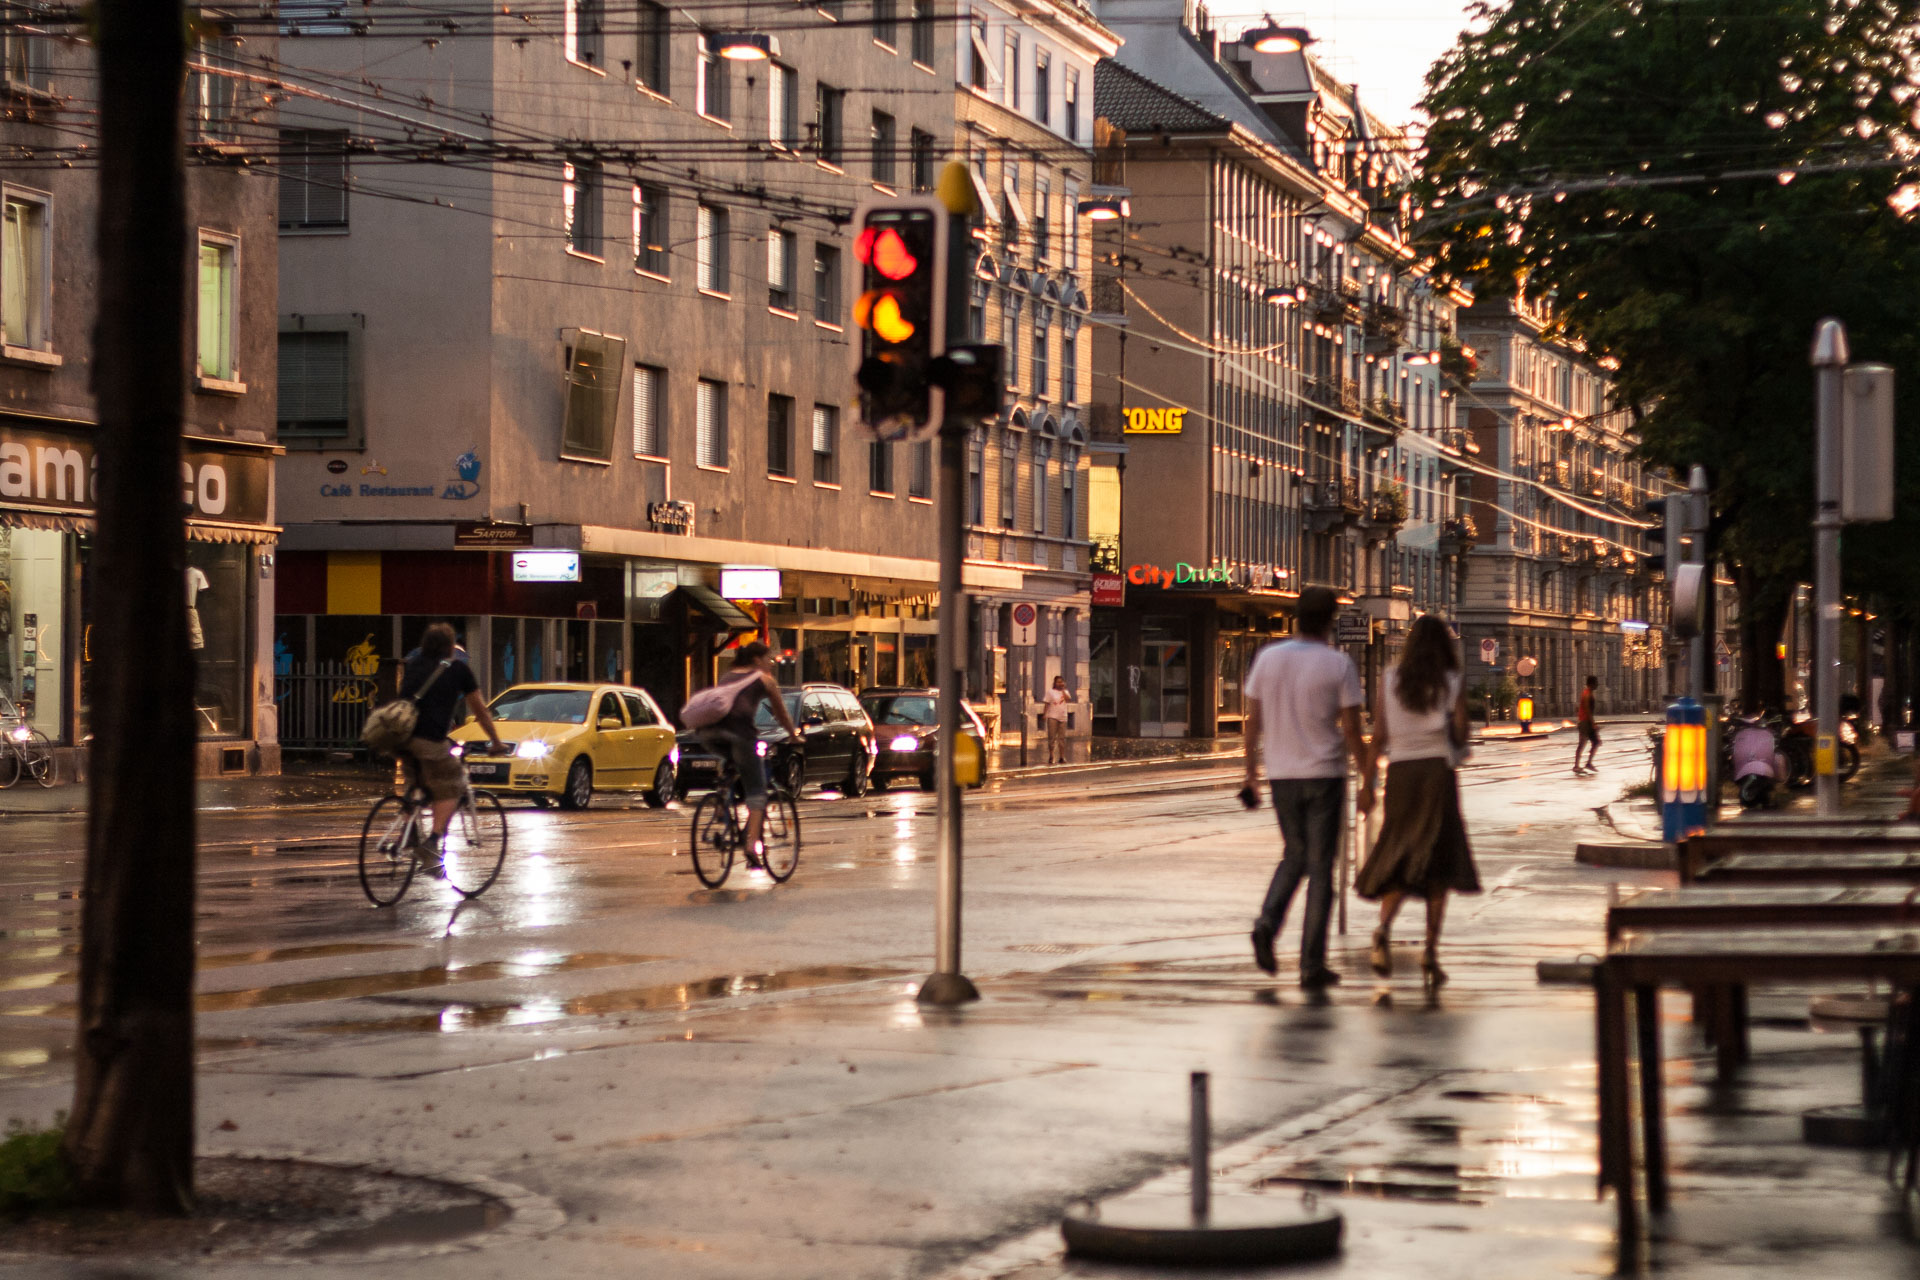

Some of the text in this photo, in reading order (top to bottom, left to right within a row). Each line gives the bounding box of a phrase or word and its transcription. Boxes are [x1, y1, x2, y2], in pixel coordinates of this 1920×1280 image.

[320, 484, 352, 497] Café
[360, 484, 434, 496] Restaurant
[473, 528, 518, 538] SARTORI
[1356, 617, 1369, 626] TV
